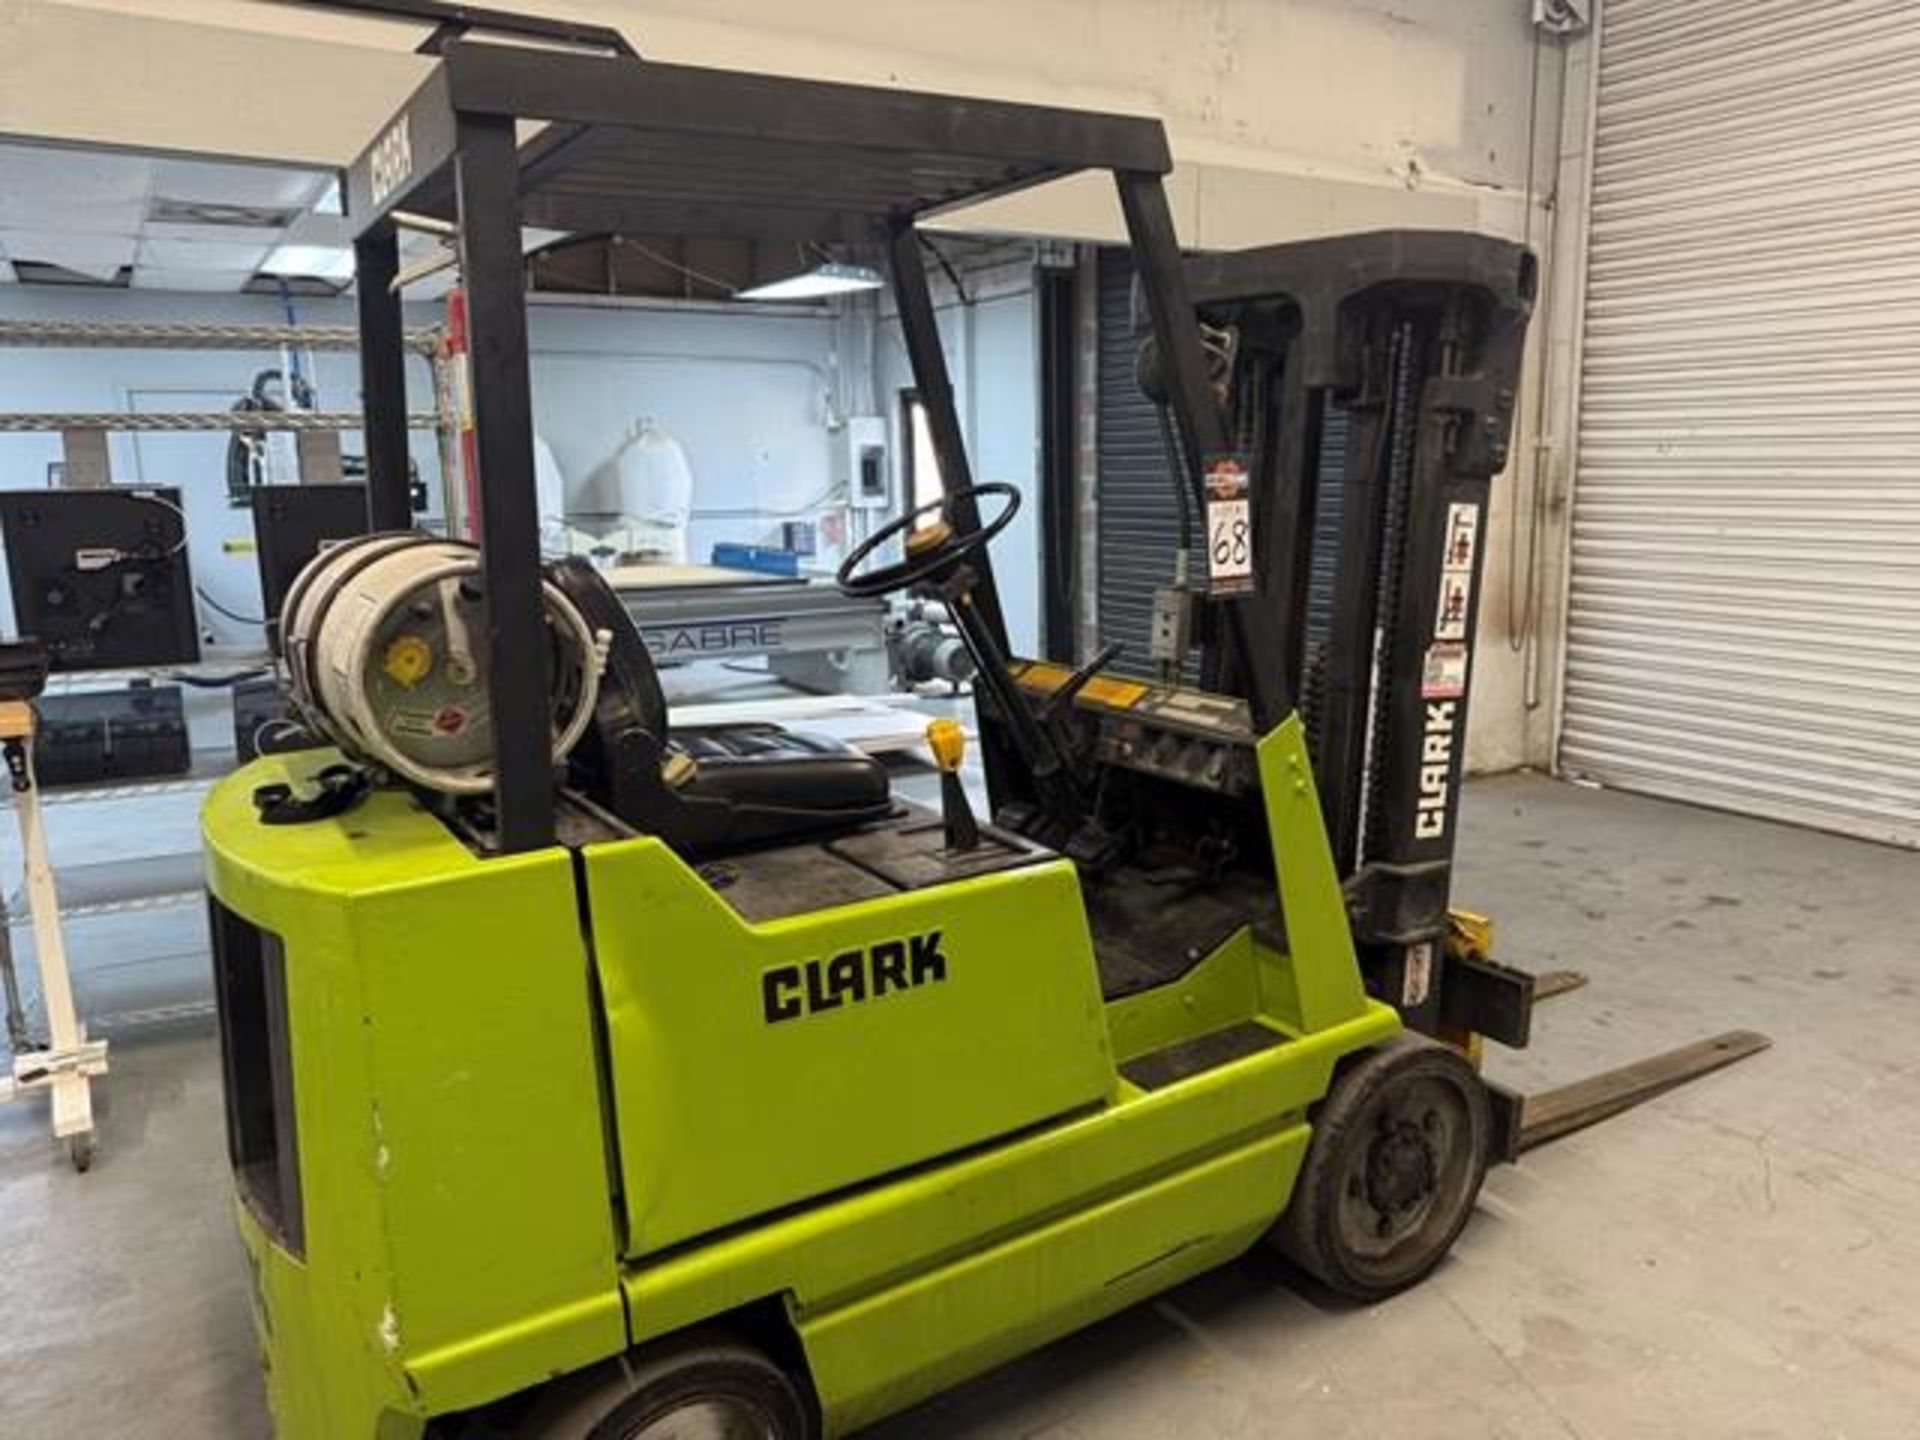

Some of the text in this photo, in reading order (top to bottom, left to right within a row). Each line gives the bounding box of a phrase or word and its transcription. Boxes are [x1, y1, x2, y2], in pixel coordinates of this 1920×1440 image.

[1213, 519, 1248, 565] 68
[642, 623, 782, 654] SABRE
[1415, 700, 1457, 838] CLARK
[763, 930, 947, 1024] CLARK
